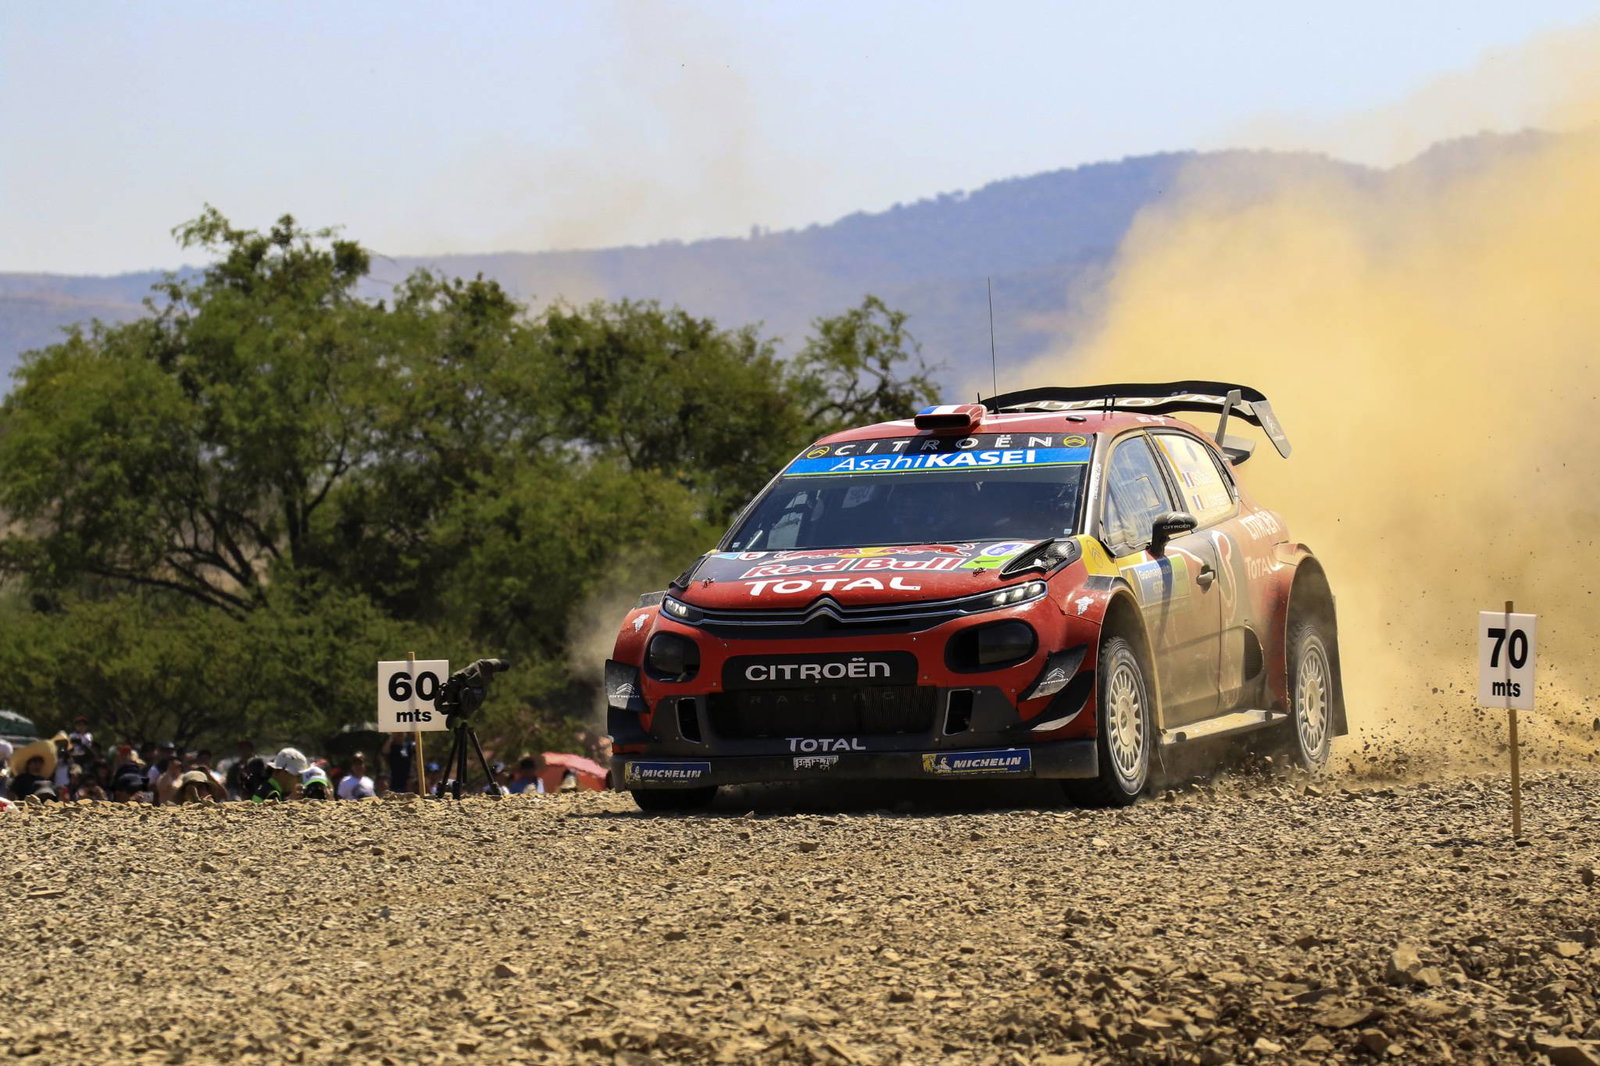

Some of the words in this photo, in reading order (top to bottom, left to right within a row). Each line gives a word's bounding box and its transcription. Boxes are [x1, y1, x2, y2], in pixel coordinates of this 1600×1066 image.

[834, 435, 1053, 456] CITROËN
[742, 558, 856, 579] Red
[856, 555, 968, 573] Bull
[744, 577, 922, 597] TOTAL
[1487, 628, 1529, 669] 70
[745, 657, 891, 681] CITROËN
[388, 671, 440, 702] 60
[1492, 678, 1521, 698] mts
[396, 708, 432, 723] mts
[785, 737, 867, 752] TOTAL
[953, 756, 1022, 769] MICHELIN
[642, 769, 702, 779] MICHELIN
